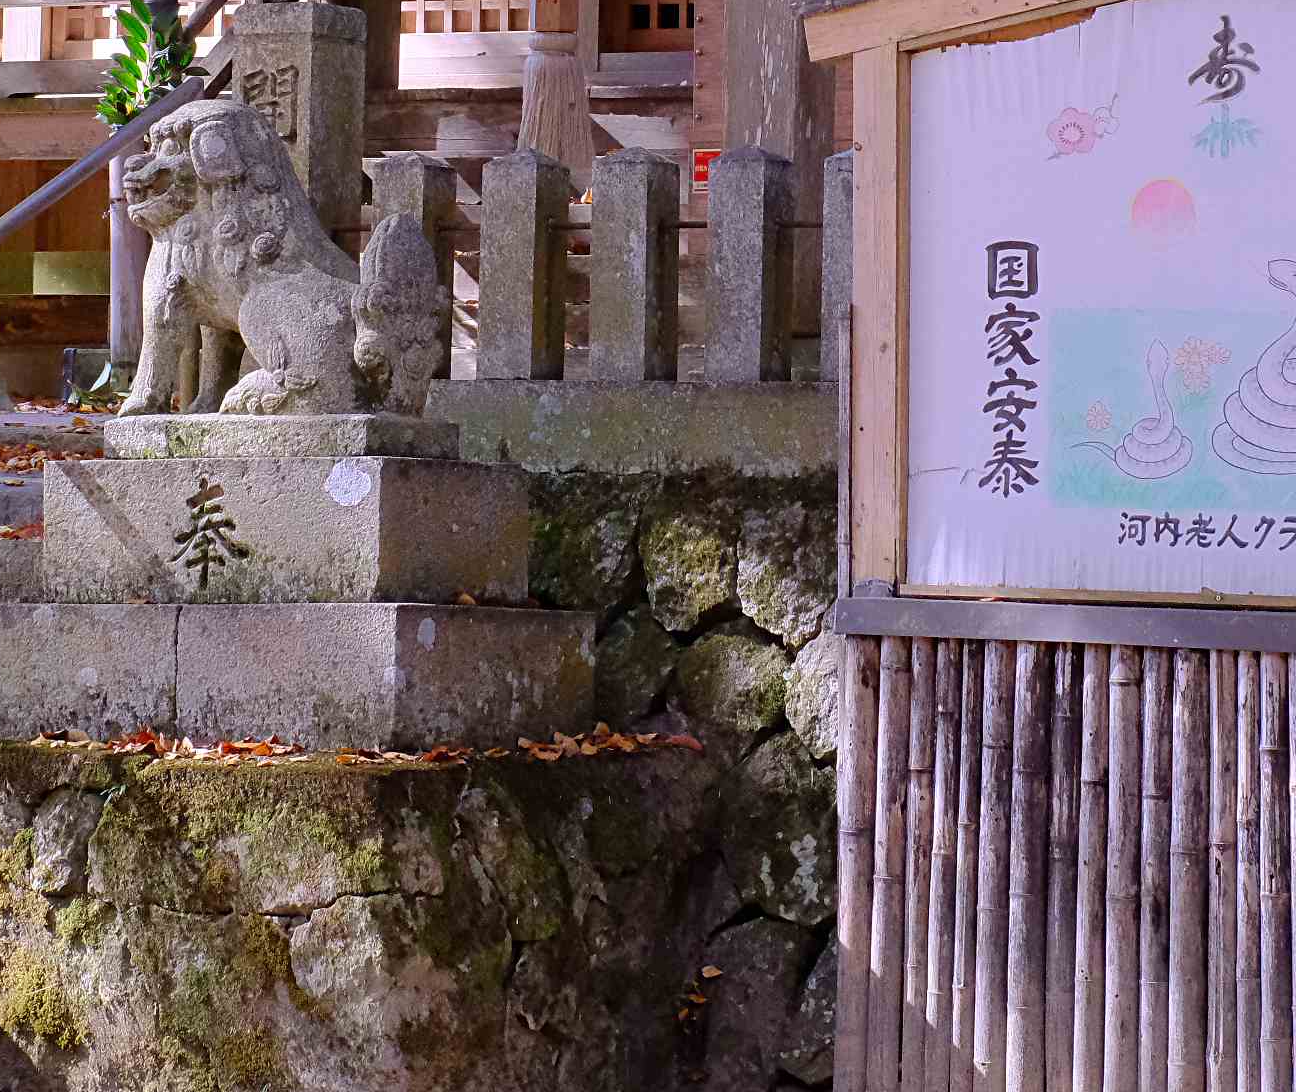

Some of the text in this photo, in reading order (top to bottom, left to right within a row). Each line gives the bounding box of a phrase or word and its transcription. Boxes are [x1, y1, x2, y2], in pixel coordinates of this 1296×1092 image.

[1188, 15, 1261, 104] 寿
[978, 240, 1041, 498] 国家安泰
[168, 477, 250, 590] 奉
